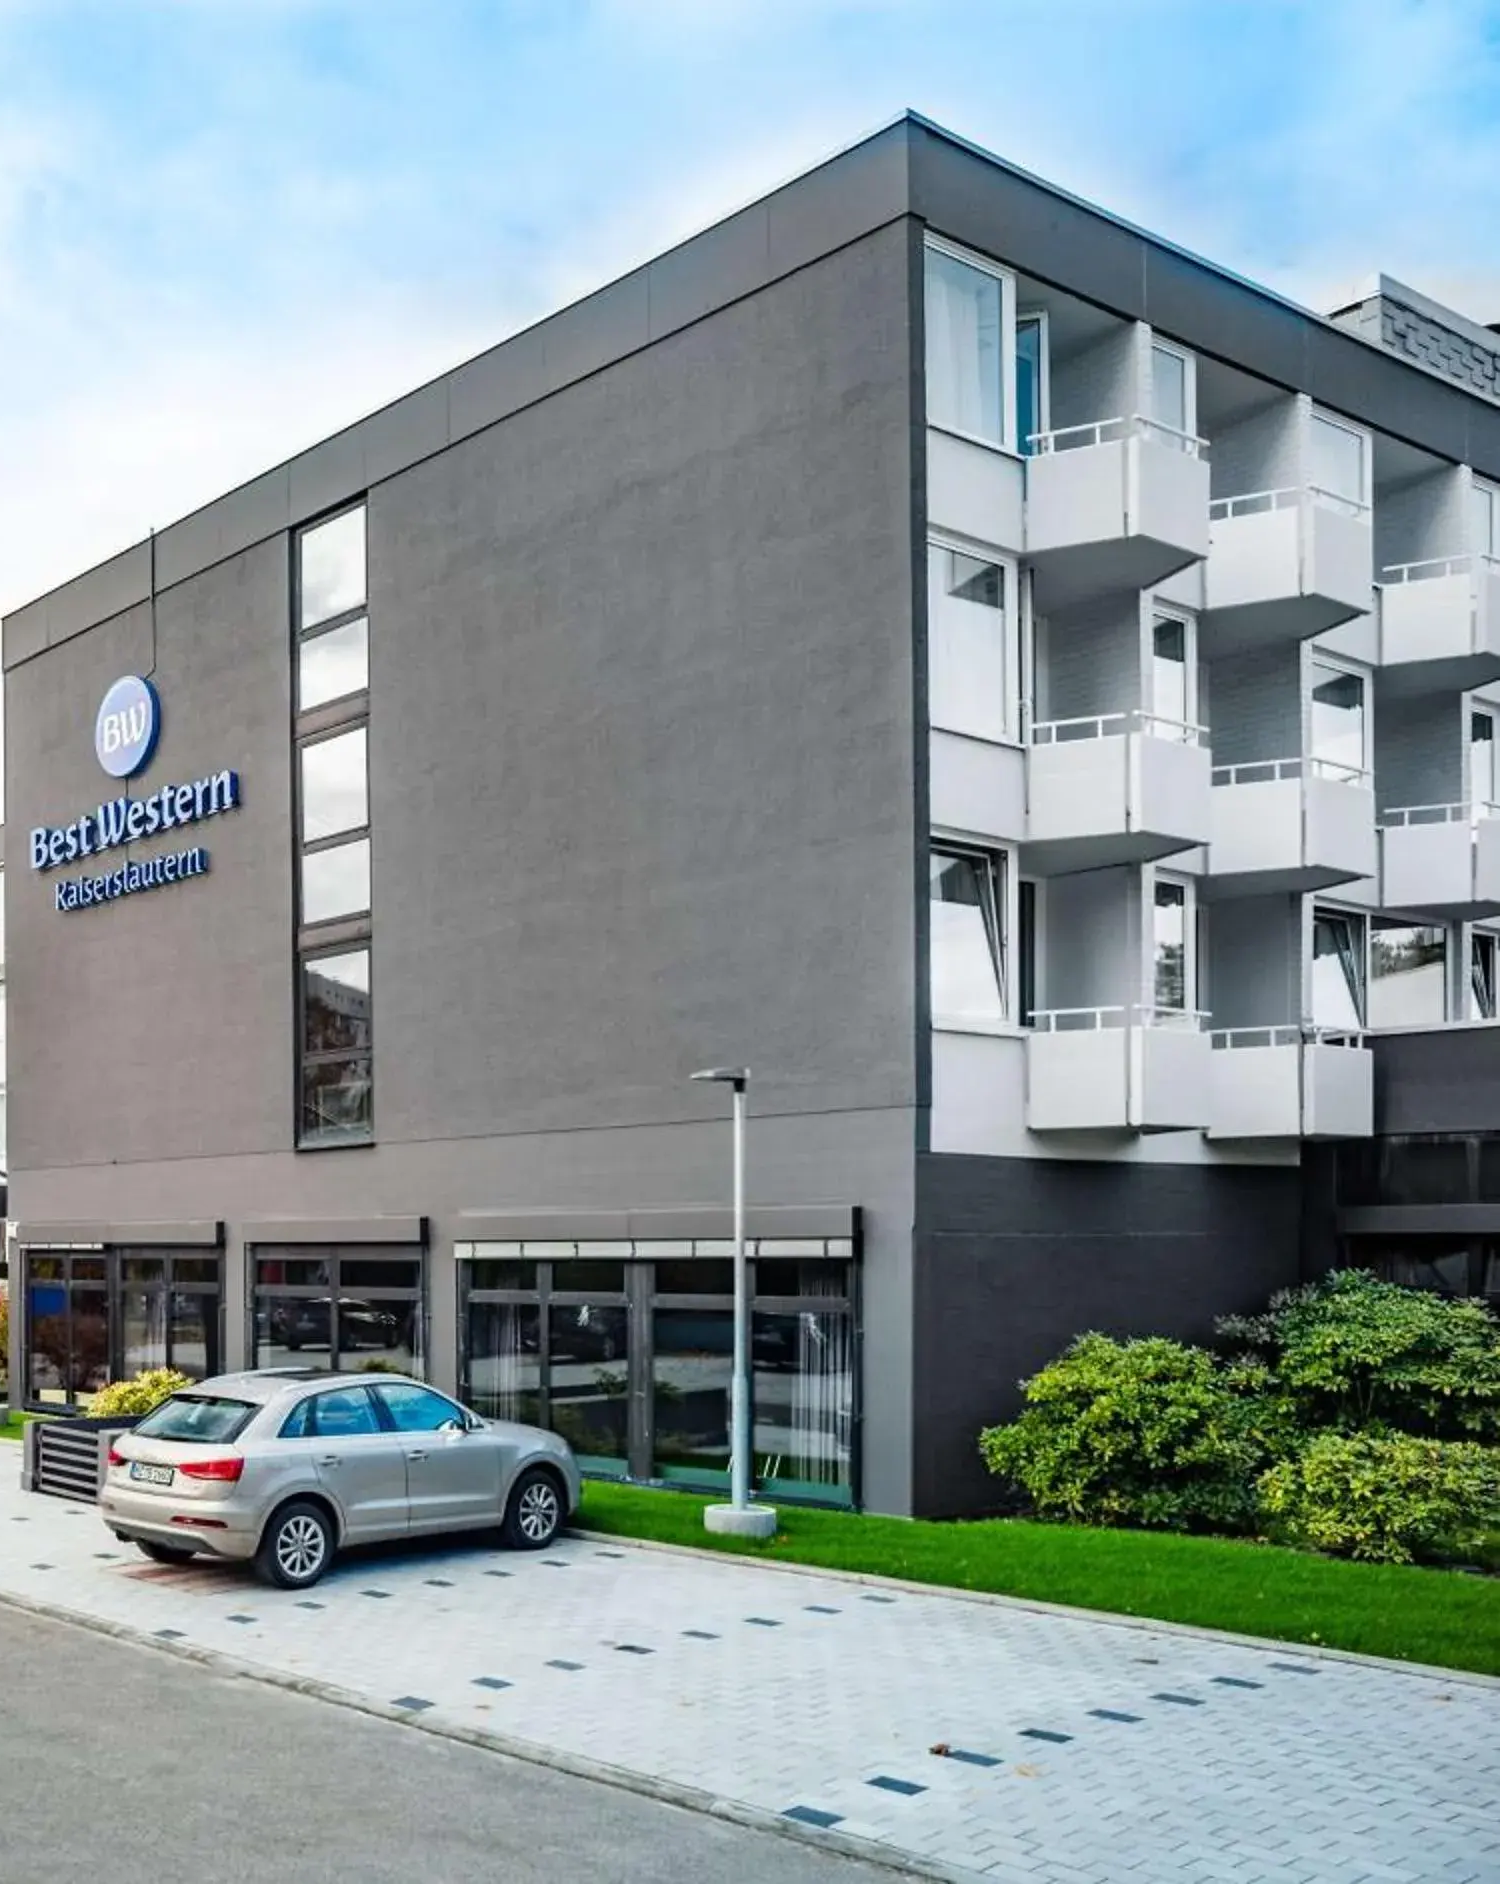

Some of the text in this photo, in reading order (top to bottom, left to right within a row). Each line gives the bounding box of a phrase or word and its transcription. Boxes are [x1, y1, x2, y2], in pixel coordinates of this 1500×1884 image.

[102, 700, 147, 754] BW
[29, 769, 235, 871] Best Western
[55, 846, 204, 911] Kaiserslautern
